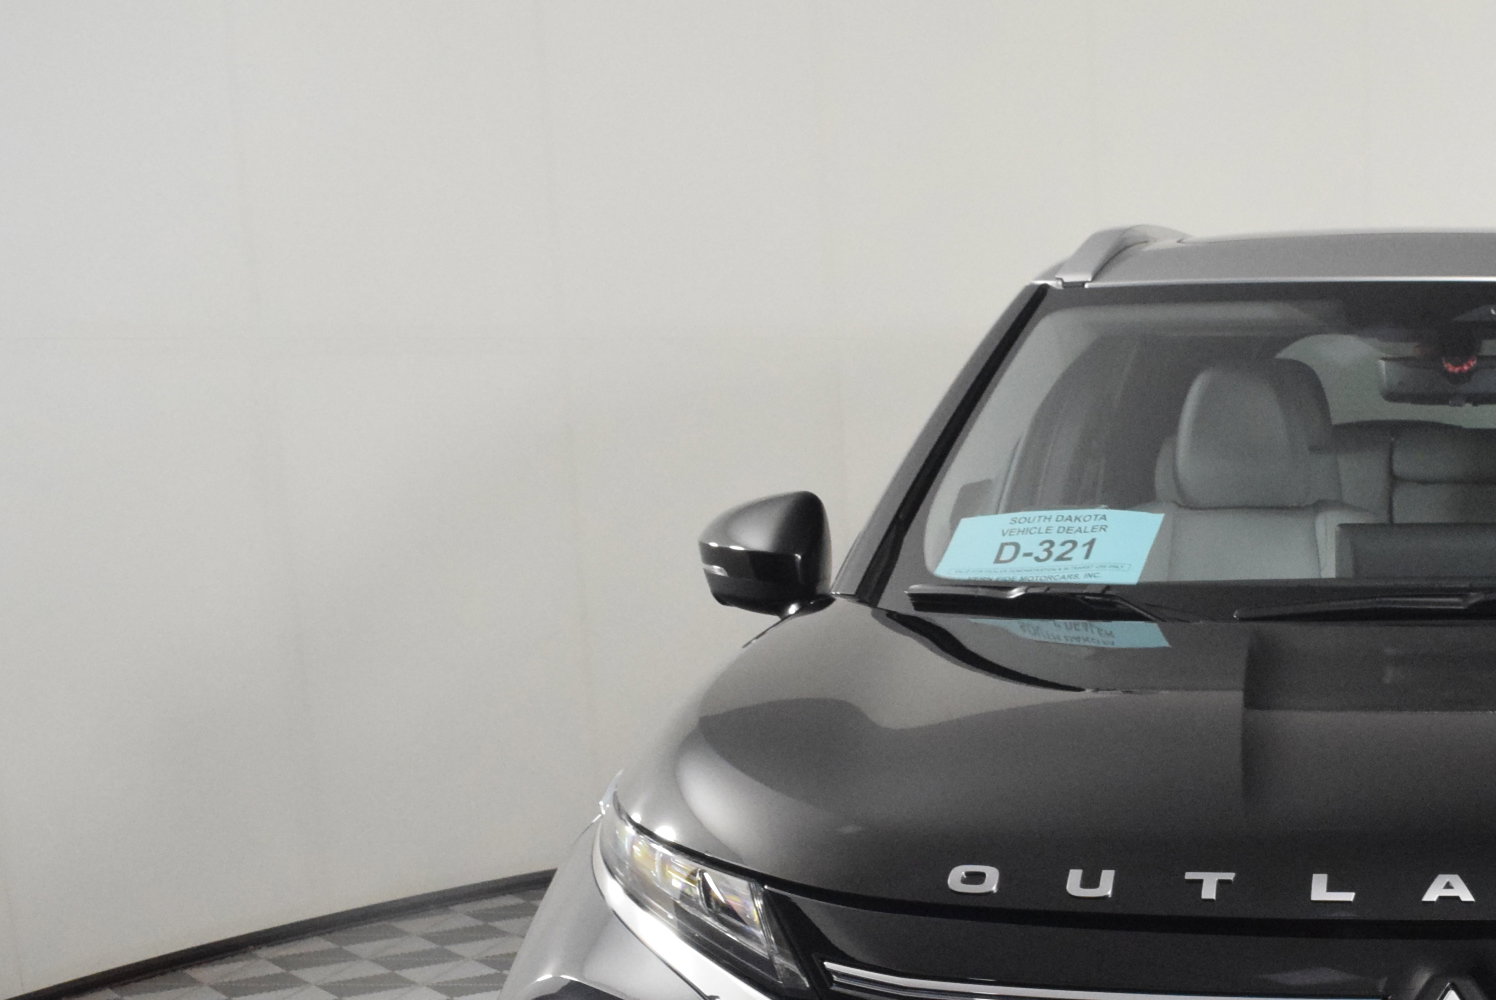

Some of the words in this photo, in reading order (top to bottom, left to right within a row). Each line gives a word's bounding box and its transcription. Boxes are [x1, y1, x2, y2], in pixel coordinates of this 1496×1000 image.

[1009, 515, 1052, 525] SOUTH
[1055, 514, 1108, 523] DAKOTA
[1001, 526, 1053, 537] VEHICLE
[1056, 525, 1108, 534] DEALER
[993, 538, 1097, 564] D-321
